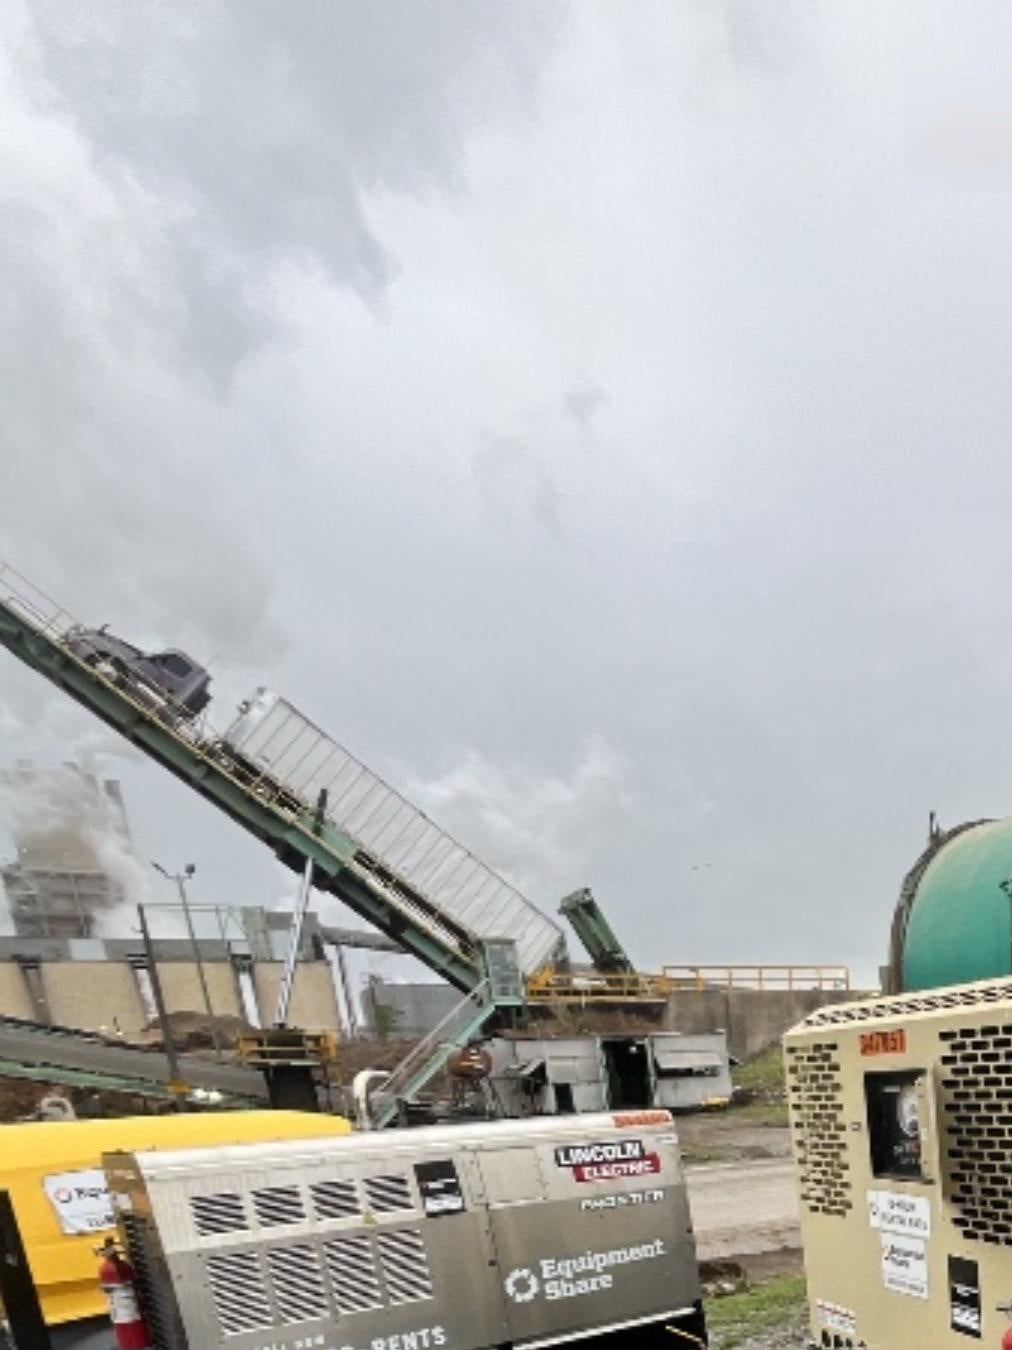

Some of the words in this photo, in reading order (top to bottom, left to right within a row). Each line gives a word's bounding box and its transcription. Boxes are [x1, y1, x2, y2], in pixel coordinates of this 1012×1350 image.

[560, 1141, 641, 1164] LINCOLN
[539, 1238, 667, 1280] Equipment
[544, 1273, 613, 1300] Share
